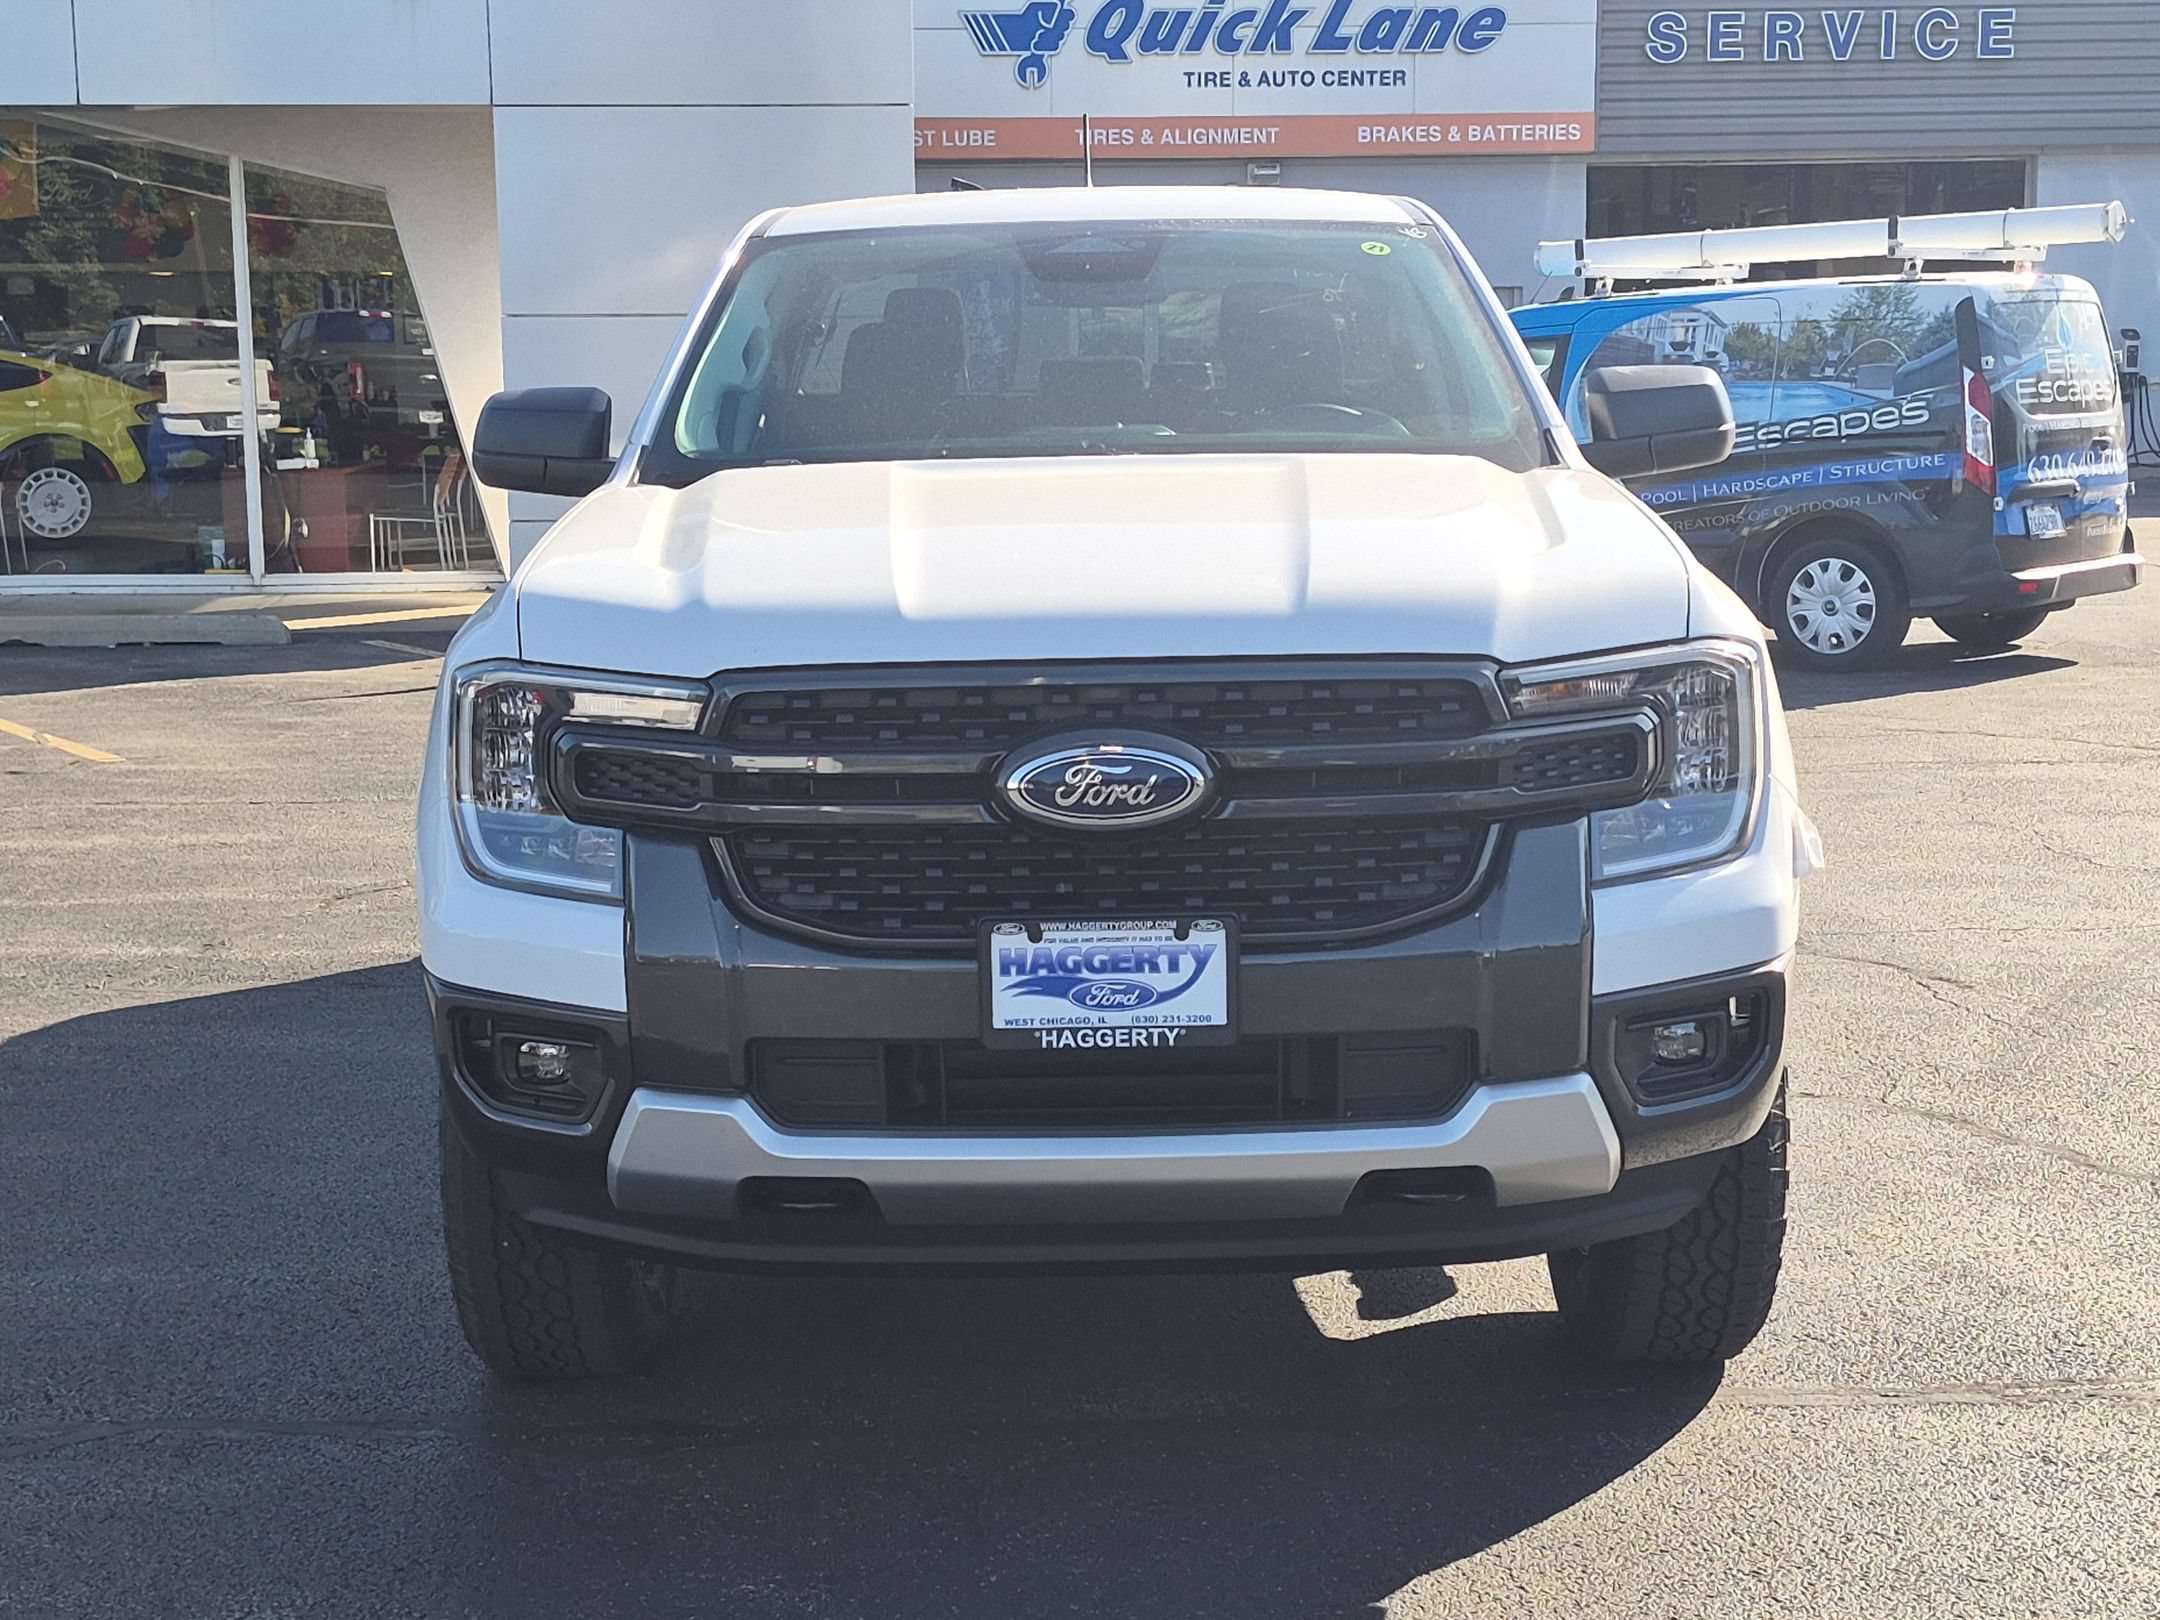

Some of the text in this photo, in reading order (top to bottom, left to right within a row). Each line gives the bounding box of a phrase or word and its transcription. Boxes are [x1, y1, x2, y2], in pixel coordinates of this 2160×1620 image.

[1085, 0, 1508, 63] Quick Lane
[1646, 8, 2016, 63] SERVICE
[1183, 69, 1407, 88] TIRE & AUTO CENTER
[942, 129, 996, 146] LUBE
[1075, 127, 1280, 146] TIRES & ALIGNMENT
[1358, 124, 1582, 143] BRAKES & BATTERIES
[2044, 347, 2096, 380] Epic
[2015, 378, 2115, 408] Escapes
[1731, 400, 1930, 455] Escapes
[1640, 453, 1946, 505] POOL HARDSCAPE STRUCTURE
[1669, 487, 1926, 532] REATORS OF OUTDOOR LIVING
[1055, 764, 1158, 807] Ford
[1040, 920, 1177, 931] WWW.HAGGERTYGROUP.COM
[1000, 945, 1217, 977] HAGGERTY
[1085, 984, 1140, 1006] Ford
[1004, 1016, 1107, 1027] WEST CHICAGO, IL
[1131, 1015, 1212, 1025] (630) 231-3200
[1040, 1027, 1181, 1048] HAGGERTY
